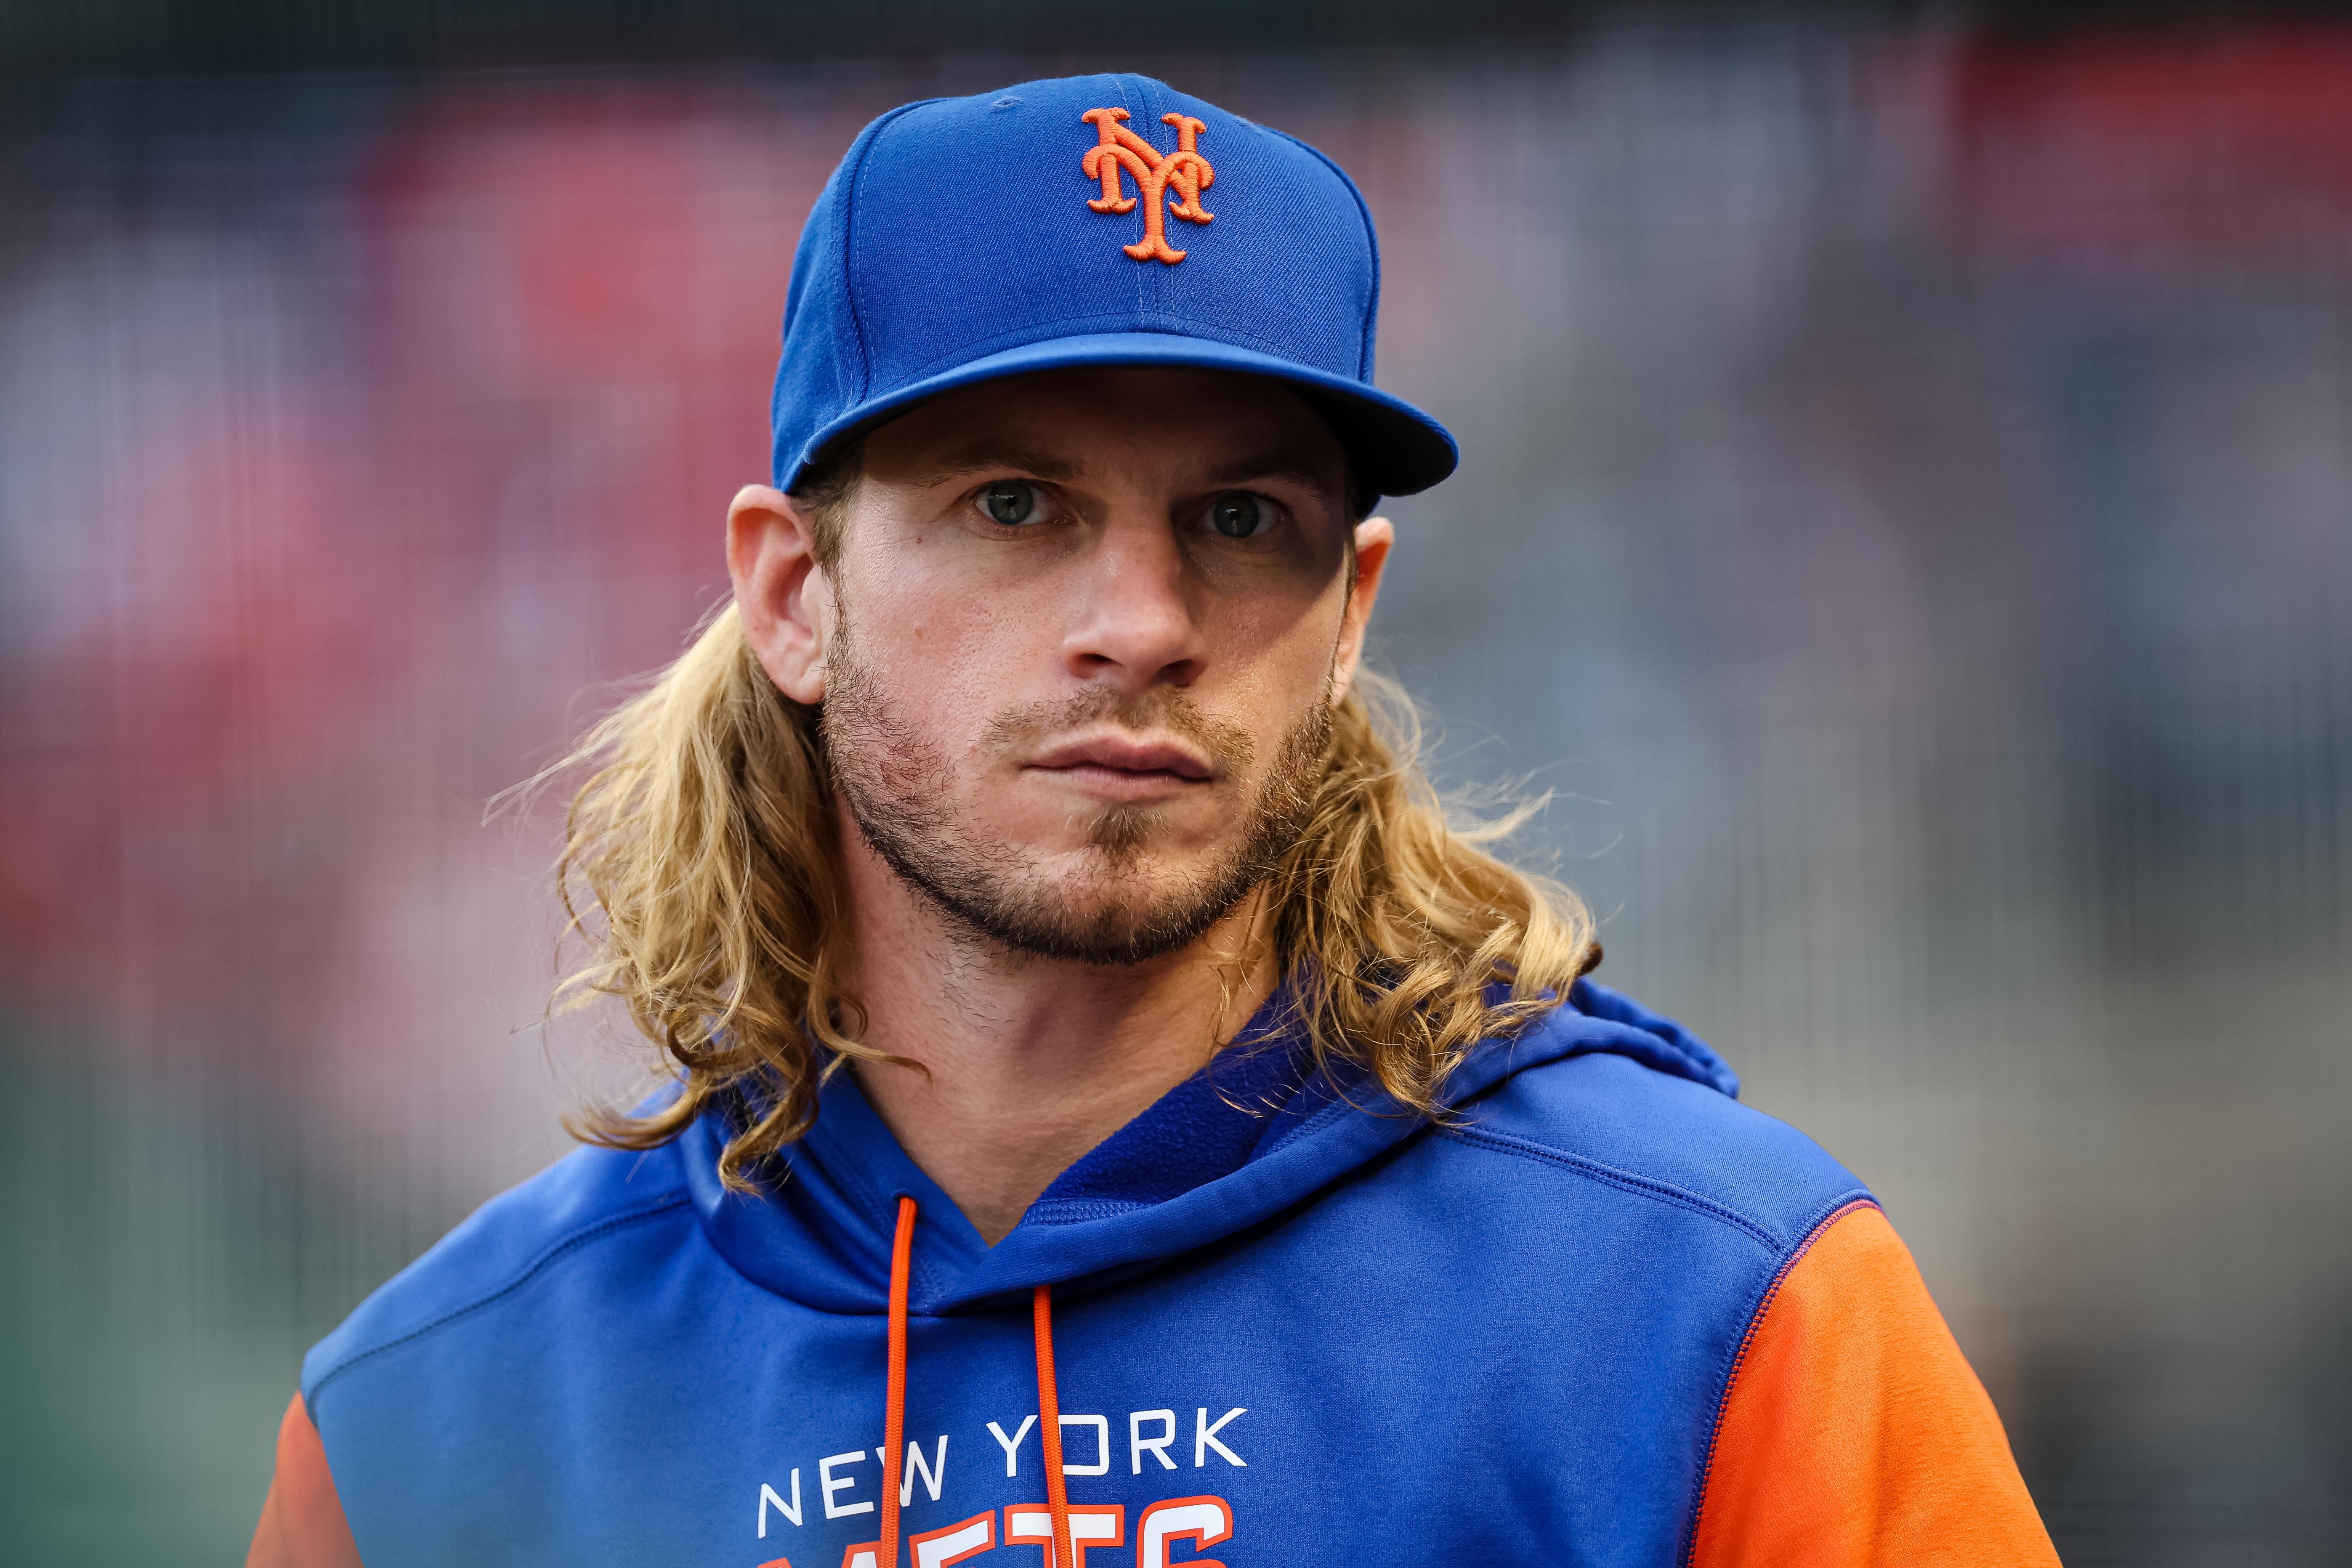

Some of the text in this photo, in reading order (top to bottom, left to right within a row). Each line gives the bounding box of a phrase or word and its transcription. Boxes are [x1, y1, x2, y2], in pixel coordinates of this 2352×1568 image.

[1082, 107, 1215, 264] NY
[757, 1435, 949, 1539] NEW
[986, 1407, 1248, 1478] YORK
